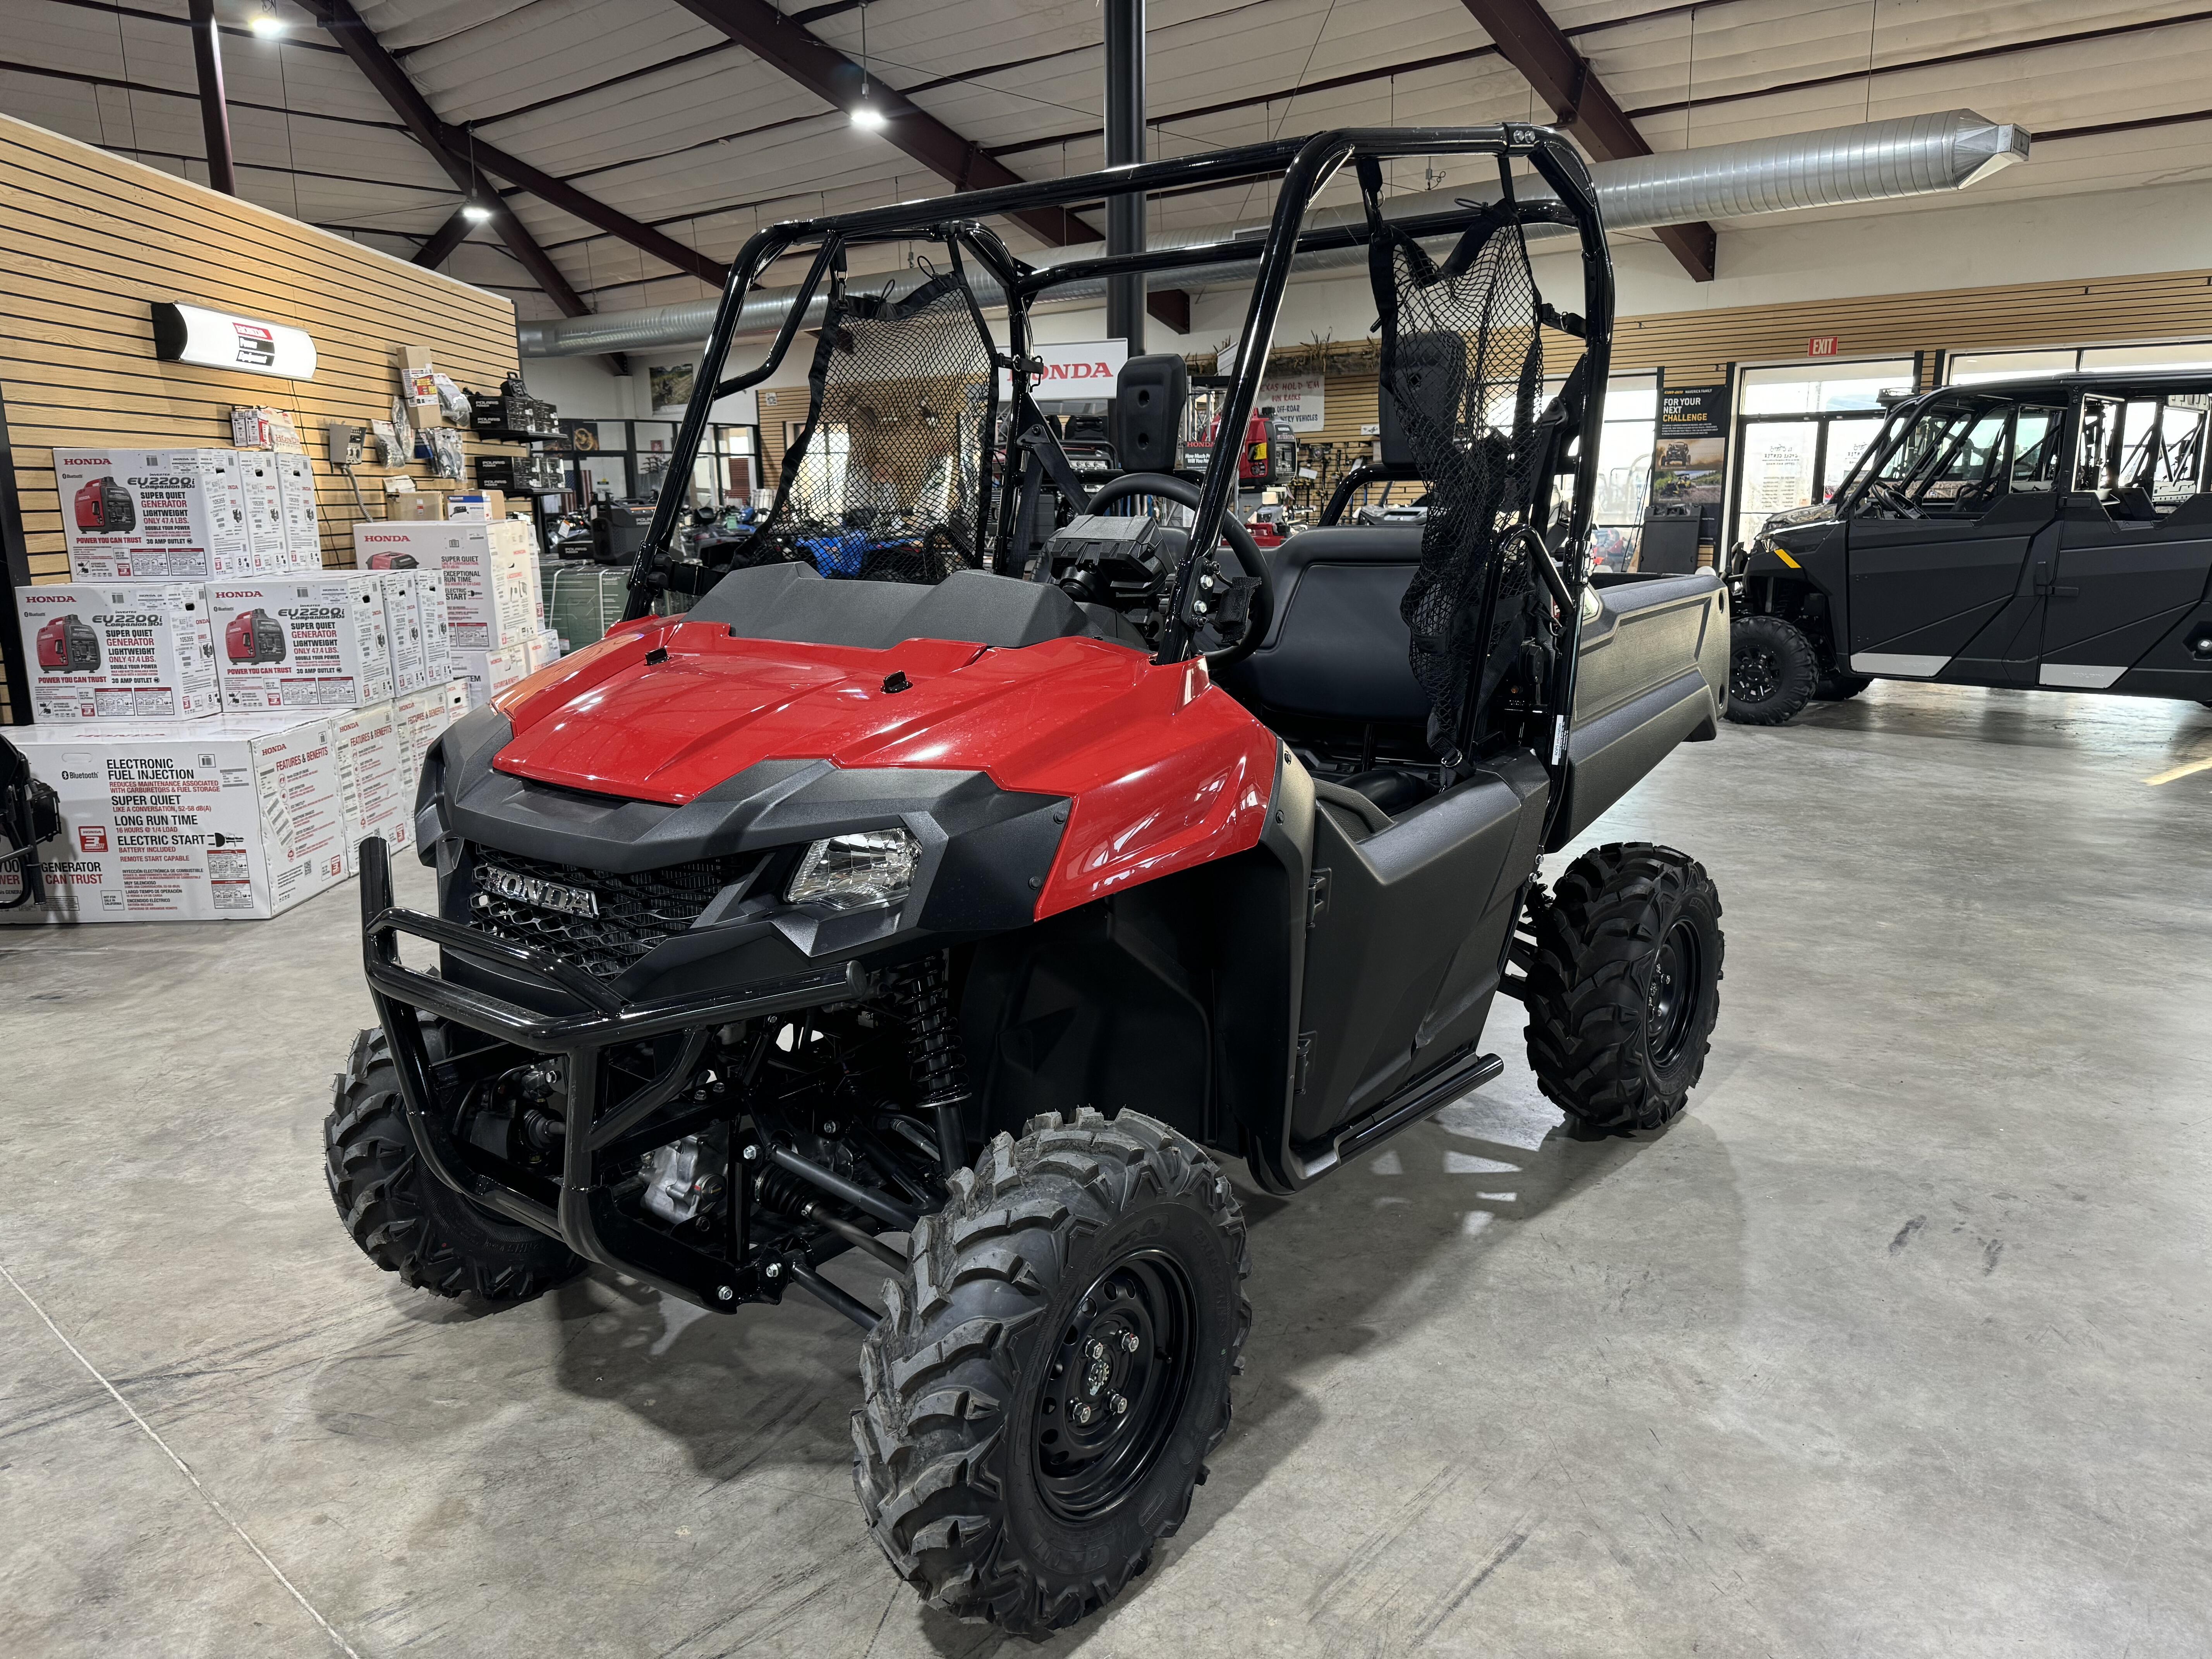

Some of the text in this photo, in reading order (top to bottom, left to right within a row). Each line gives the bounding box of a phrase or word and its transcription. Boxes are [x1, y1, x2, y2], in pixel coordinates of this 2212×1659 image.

[1812, 338, 1834, 354] EXIT
[1007, 362, 1113, 381] ONDA
[1260, 383, 1279, 392] EXAS
[1283, 383, 1302, 391] HOLD
[1680, 397, 1701, 406] YOUR
[1663, 413, 1707, 422] CHALLENGE
[127, 477, 195, 485] EU2200i
[166, 492, 185, 500] QUIET
[278, 608, 344, 616] EU2200i
[92, 615, 162, 623] EU2200i
[316, 622, 335, 631] QUIET
[132, 630, 152, 638] QUIET
[292, 630, 337, 639] GENERATOR
[106, 638, 154, 646] GENERATOR
[399, 702, 415, 712] HONDA
[340, 722, 359, 733] HONDA
[350, 732, 370, 747] FEATURES
[374, 725, 392, 738] BENEFITS
[262, 744, 287, 756] HONDA
[106, 759, 173, 769] ELECTRONIC
[276, 747, 328, 772] FEATURES & BENEFITS
[108, 769, 194, 780] FUEL INJECTION
[112, 795, 181, 805] SUPER QUIET
[115, 815, 198, 826] LONG RUN TIME
[117, 835, 205, 845] ELECTRIC START
[41, 862, 101, 872] GENERATOR
[45, 874, 103, 884] CAN TRUST
[484, 867, 593, 918] HONDA
